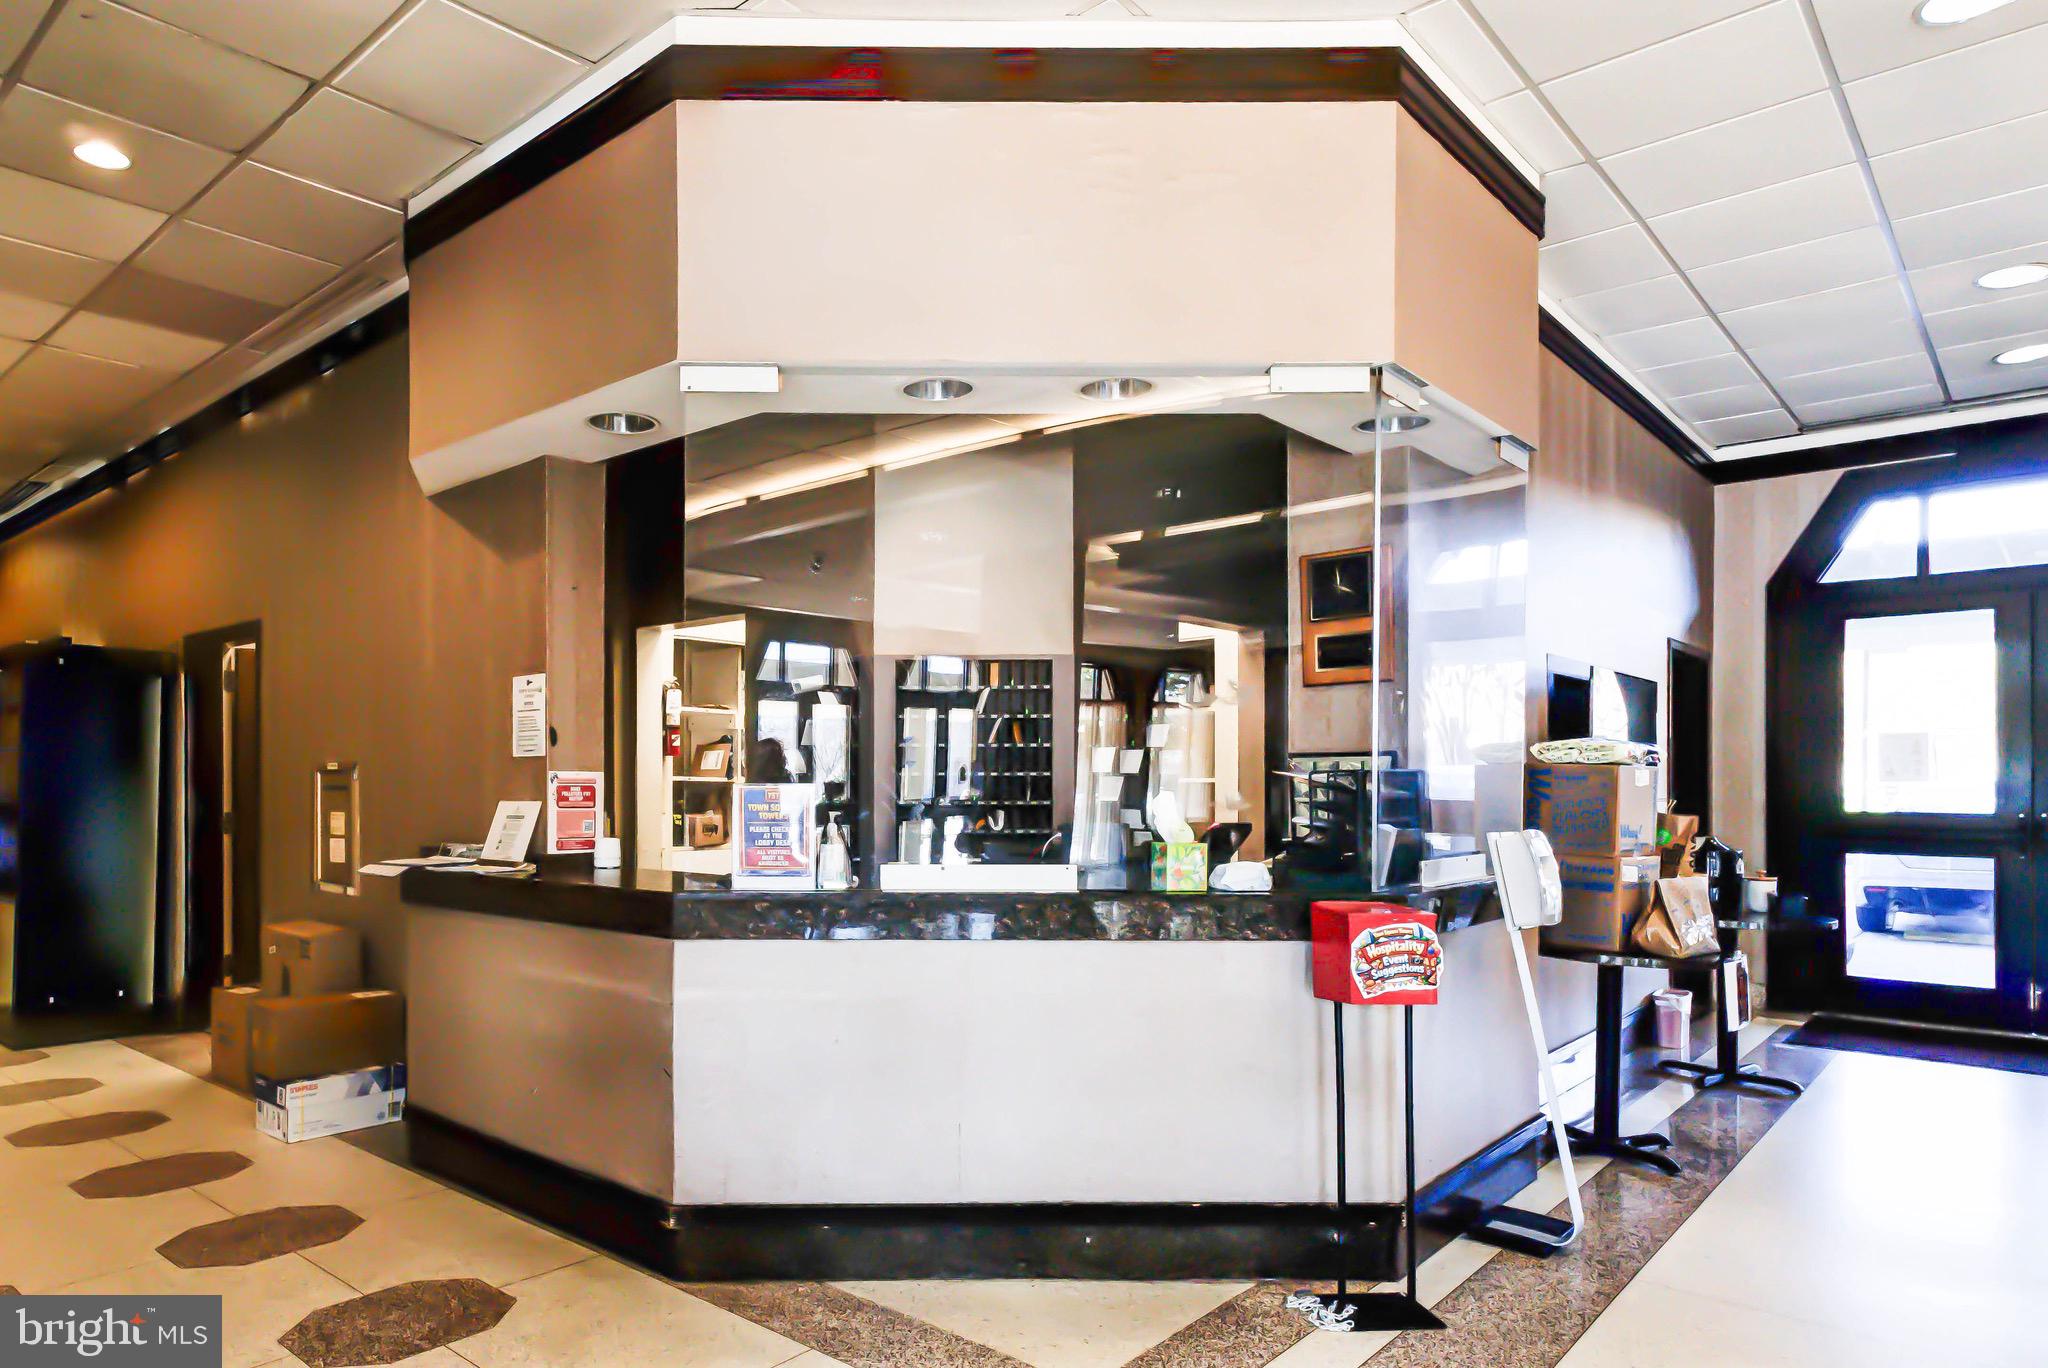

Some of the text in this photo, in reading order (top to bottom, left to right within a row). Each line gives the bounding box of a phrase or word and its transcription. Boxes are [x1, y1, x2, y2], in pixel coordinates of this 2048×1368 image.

[1365, 940, 1425, 959] Hospitality
[1382, 954, 1409, 966] Event
[1371, 964, 1425, 980] Suggestions
